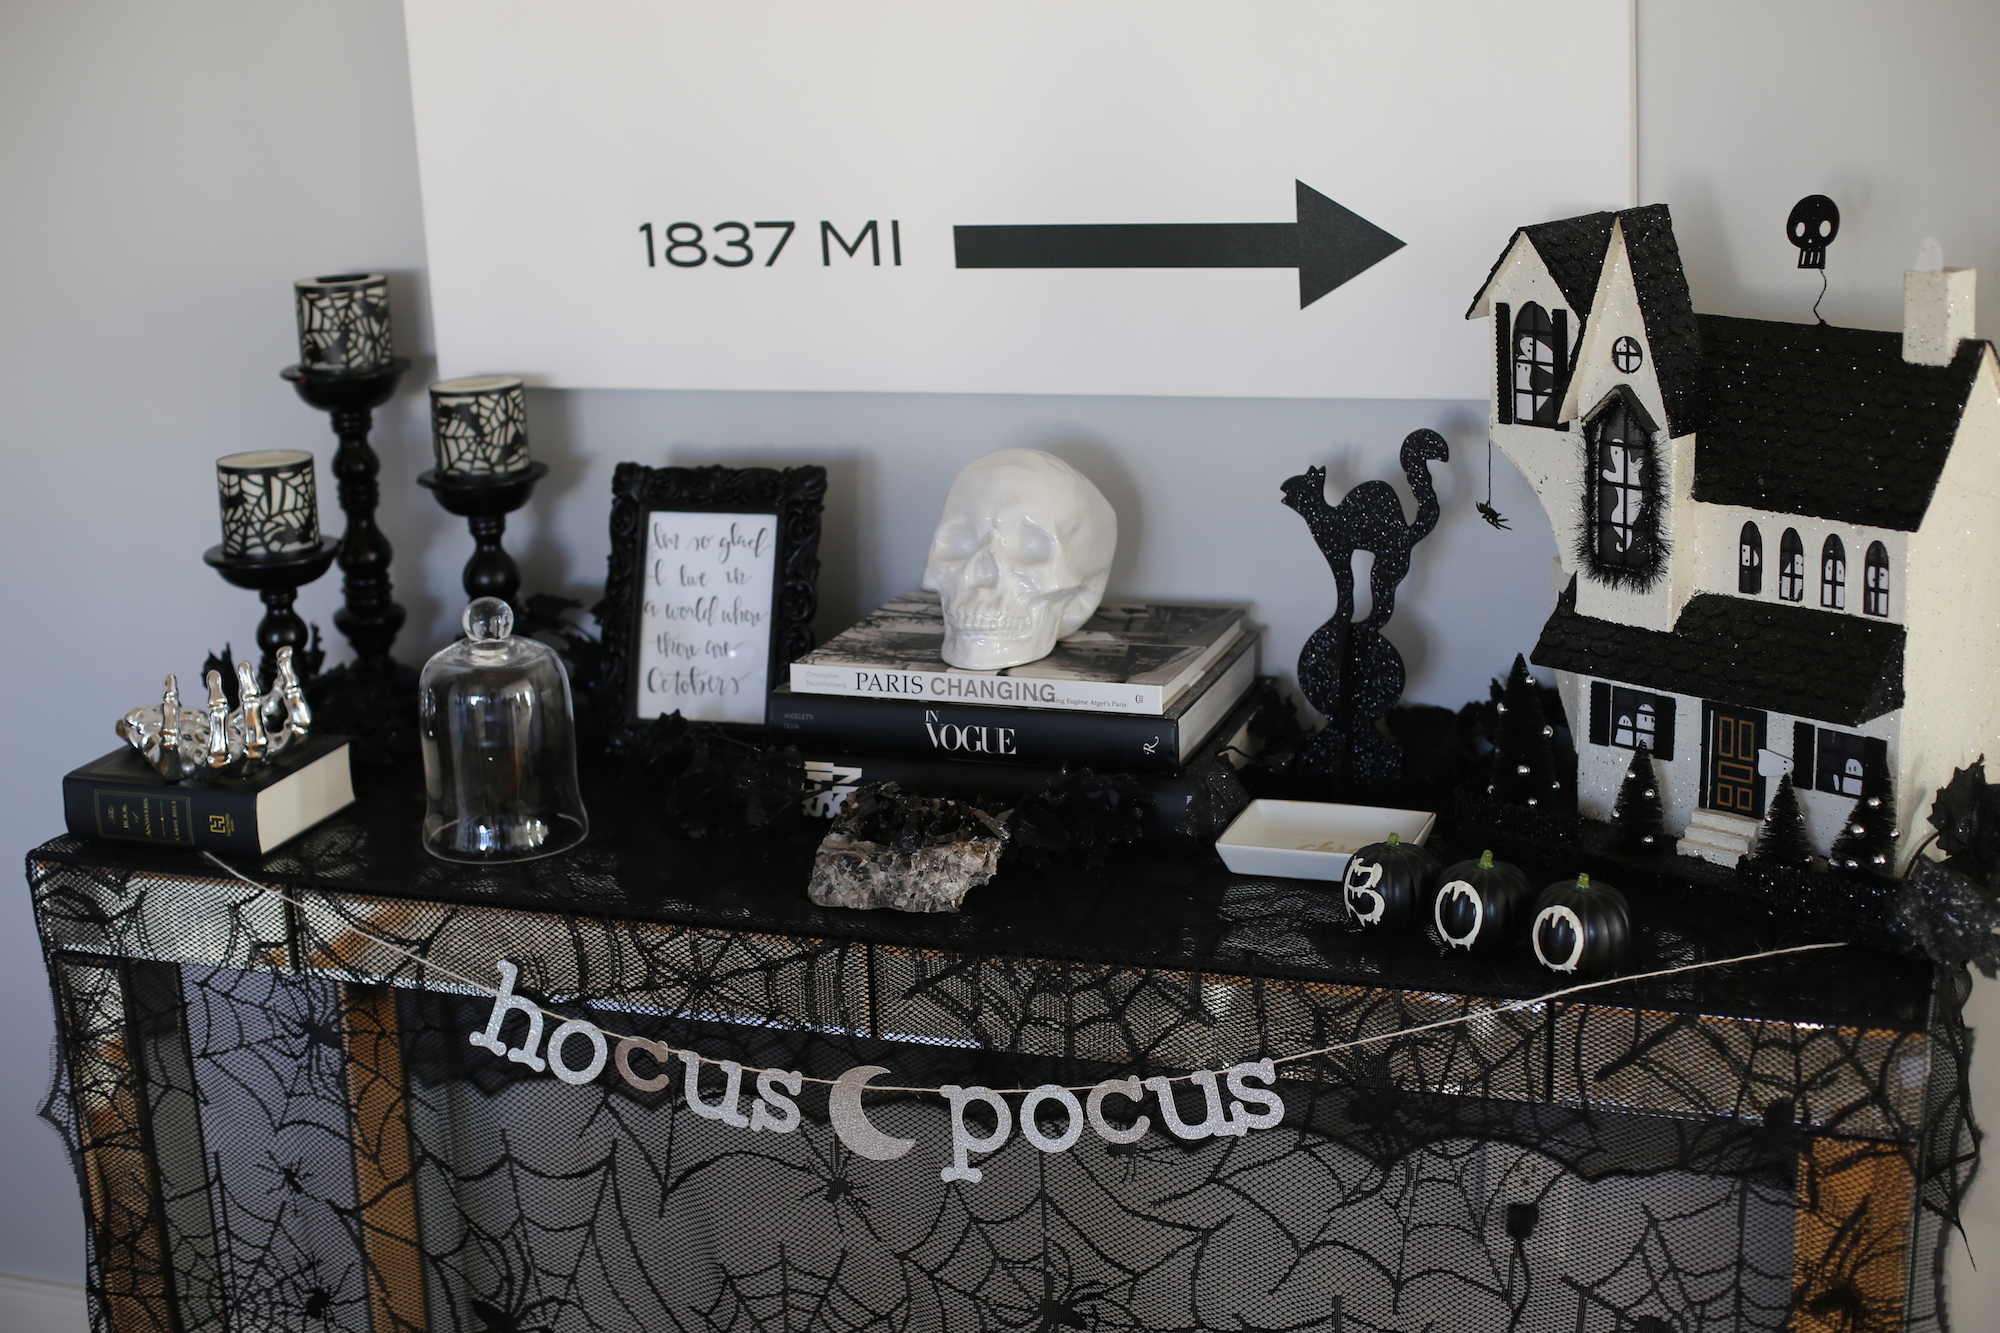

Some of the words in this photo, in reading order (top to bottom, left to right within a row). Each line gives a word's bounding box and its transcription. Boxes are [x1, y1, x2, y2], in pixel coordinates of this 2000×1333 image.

[639, 221, 795, 268] 1837
[820, 220, 902, 266] MI
[688, 534, 714, 551] so
[719, 521, 772, 564] glad
[678, 563, 708, 588] live
[725, 566, 753, 586] in
[644, 599, 660, 620] a
[665, 596, 719, 627] world
[721, 596, 768, 627] where
[652, 630, 700, 661] there
[704, 639, 743, 660] are
[647, 665, 750, 697] Octobers
[805, 671, 840, 681] Christopher
[855, 671, 924, 695] PARIS
[930, 676, 1056, 704] CHANGING
[925, 709, 939, 723] IN
[1066, 698, 1089, 708] Eugène
[1089, 699, 1111, 709] Atget's
[1111, 701, 1128, 709] Paris
[925, 722, 1017, 755] VOGUE
[121, 803, 130, 829] BOOK
[142, 797, 152, 838] ANSWERS
[469, 958, 803, 1134] hocus
[939, 1057, 1285, 1183] pocus
